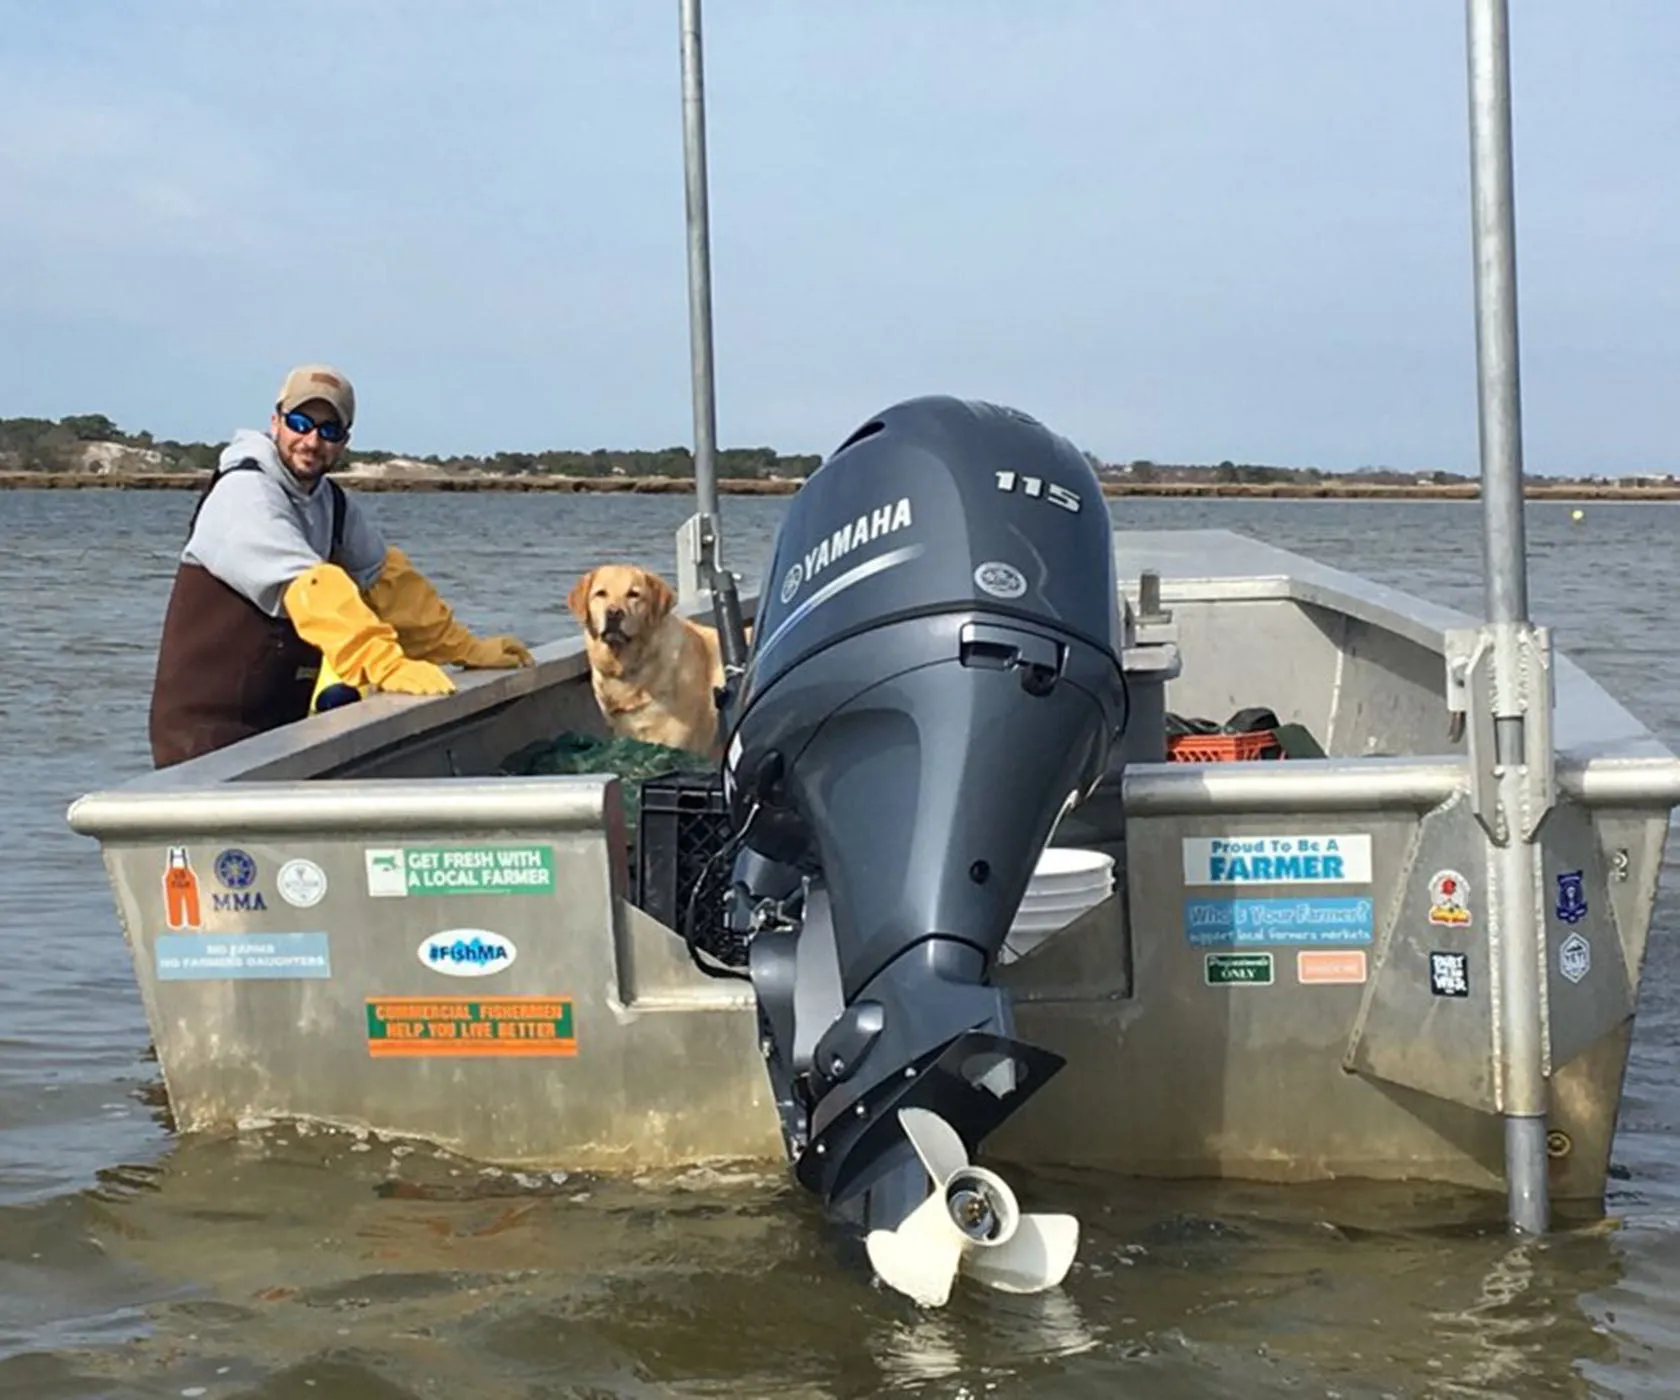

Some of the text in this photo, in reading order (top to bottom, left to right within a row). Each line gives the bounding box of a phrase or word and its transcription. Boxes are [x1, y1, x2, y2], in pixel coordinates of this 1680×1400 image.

[995, 470, 1081, 513] 115
[803, 497, 912, 582] YAMAHA
[1211, 839, 1339, 853] Proud To Be A
[408, 850, 541, 868] GET FRESH WITH
[1210, 855, 1345, 880] FARMER
[408, 868, 549, 887] A LOCAL FARMER
[212, 891, 268, 911] MMA
[1221, 967, 1256, 979] ONLY
[387, 1021, 556, 1038] HELP YOU LIVE BETTER
